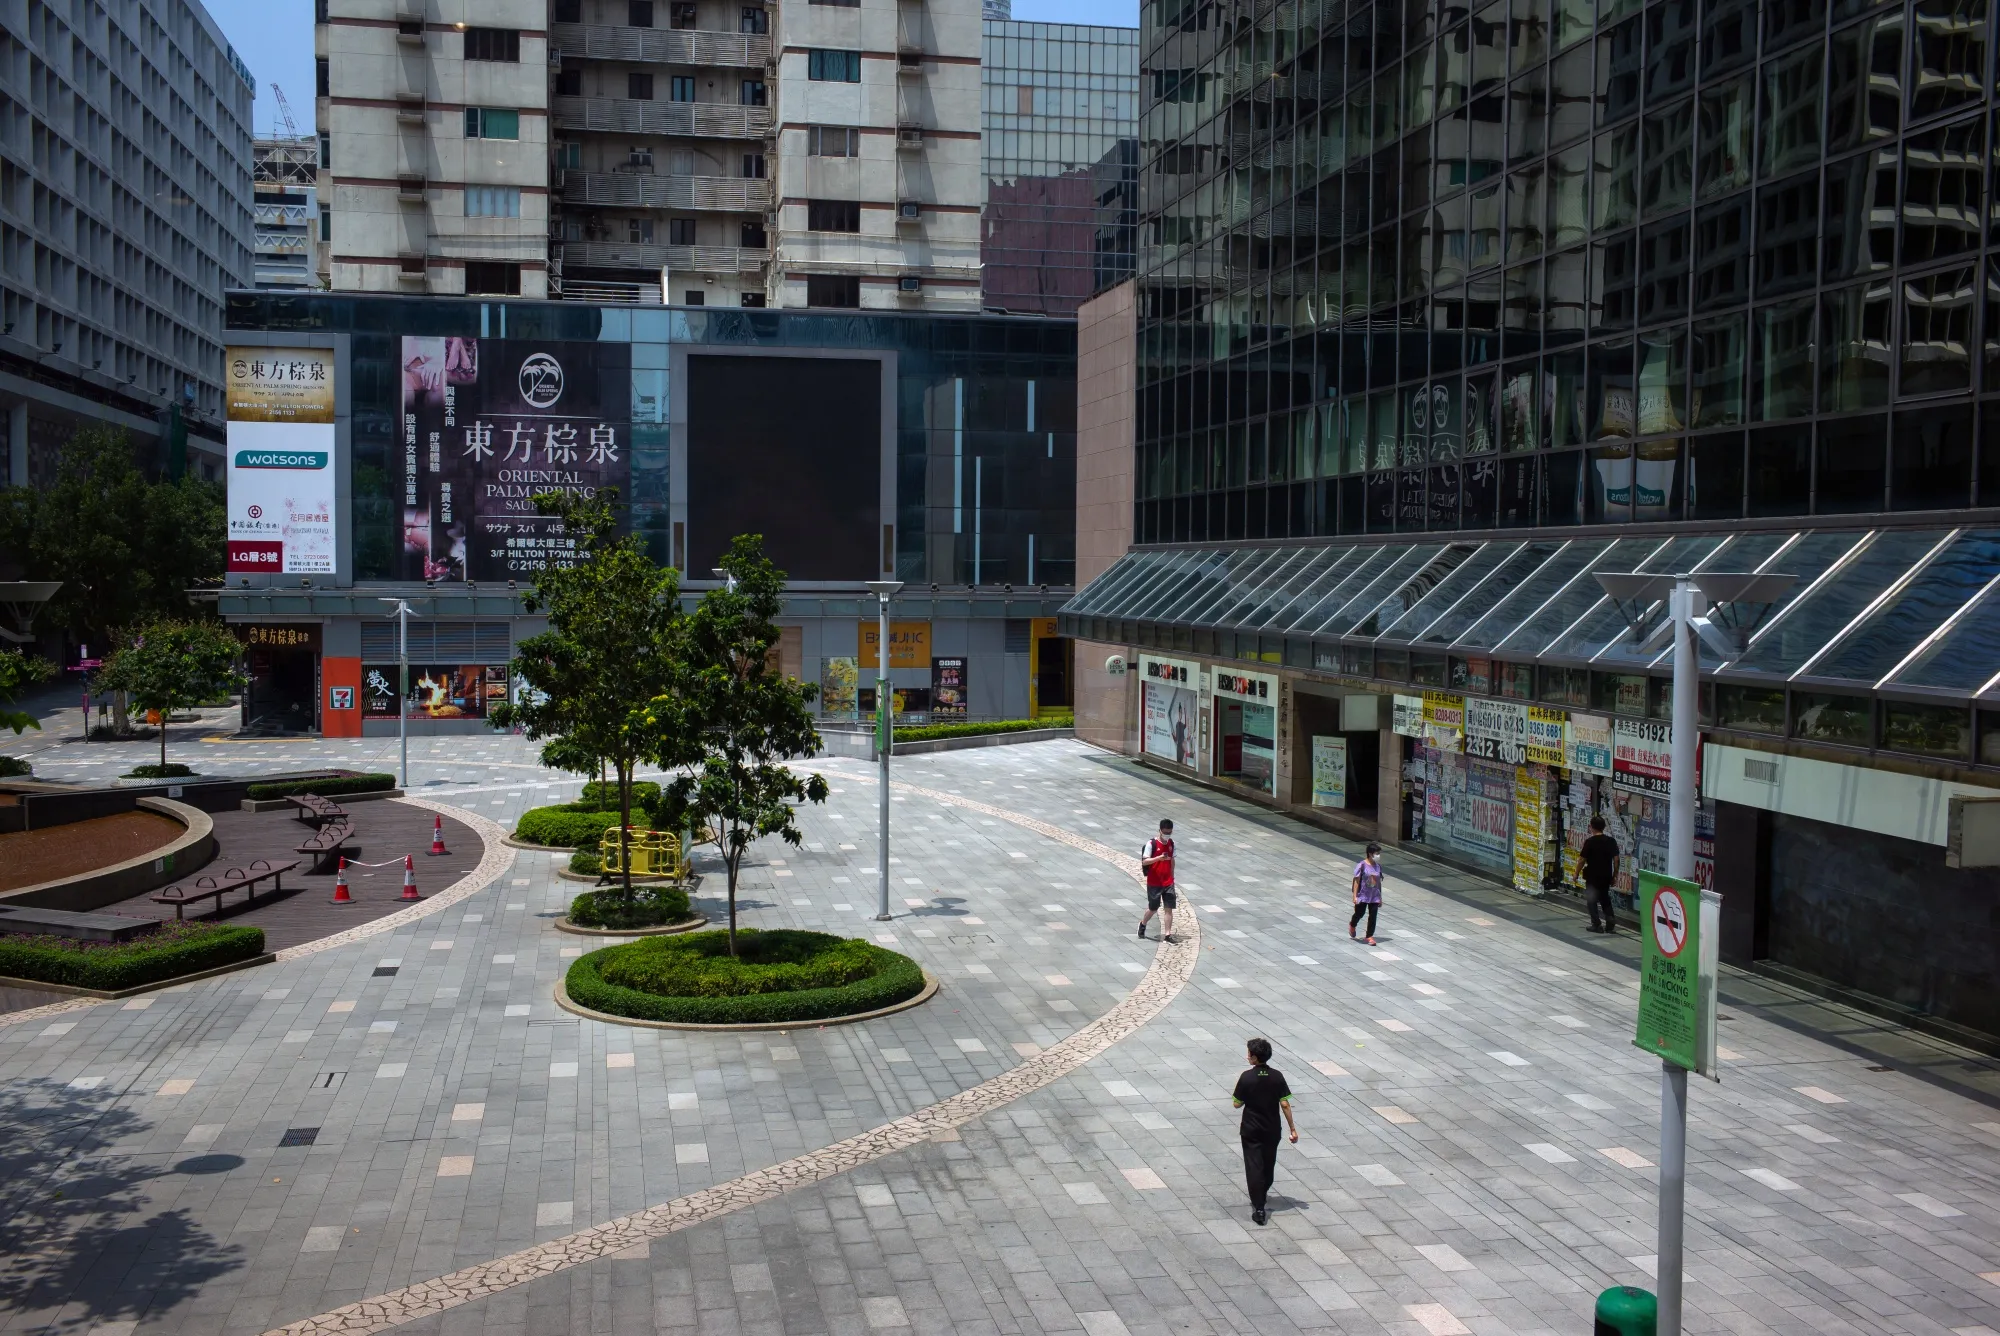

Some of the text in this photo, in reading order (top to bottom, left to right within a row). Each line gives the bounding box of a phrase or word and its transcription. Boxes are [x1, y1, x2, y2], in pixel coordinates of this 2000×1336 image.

[250, 360, 325, 381] 東方棕泉
[445, 386, 455, 427] 與眾不同
[462, 420, 619, 464] 東方棕泉
[430, 432, 440, 472] 舒適體驗
[248, 454, 316, 465] watsons
[406, 414, 416, 505] 設有男女賓獨立專區
[499, 470, 583, 483] ORIENTAL
[486, 485, 530, 498] PALM
[441, 483, 451, 523] 尊貴之選
[486, 524, 535, 532] サウナ スパ
[506, 538, 576, 548] 希爾頓大廈三樓
[232, 552, 278, 563] LG層3號
[491, 550, 504, 558] 3/F
[520, 561, 546, 570] 2156
[1218, 674, 1237, 692] HSBC
[1639, 723, 1665, 742] 6192
[1543, 738, 1555, 747] Lease
[1528, 747, 1562, 762] 27811682
[1641, 826, 1659, 840] 2392
[1659, 977, 1689, 998] SMOKING
